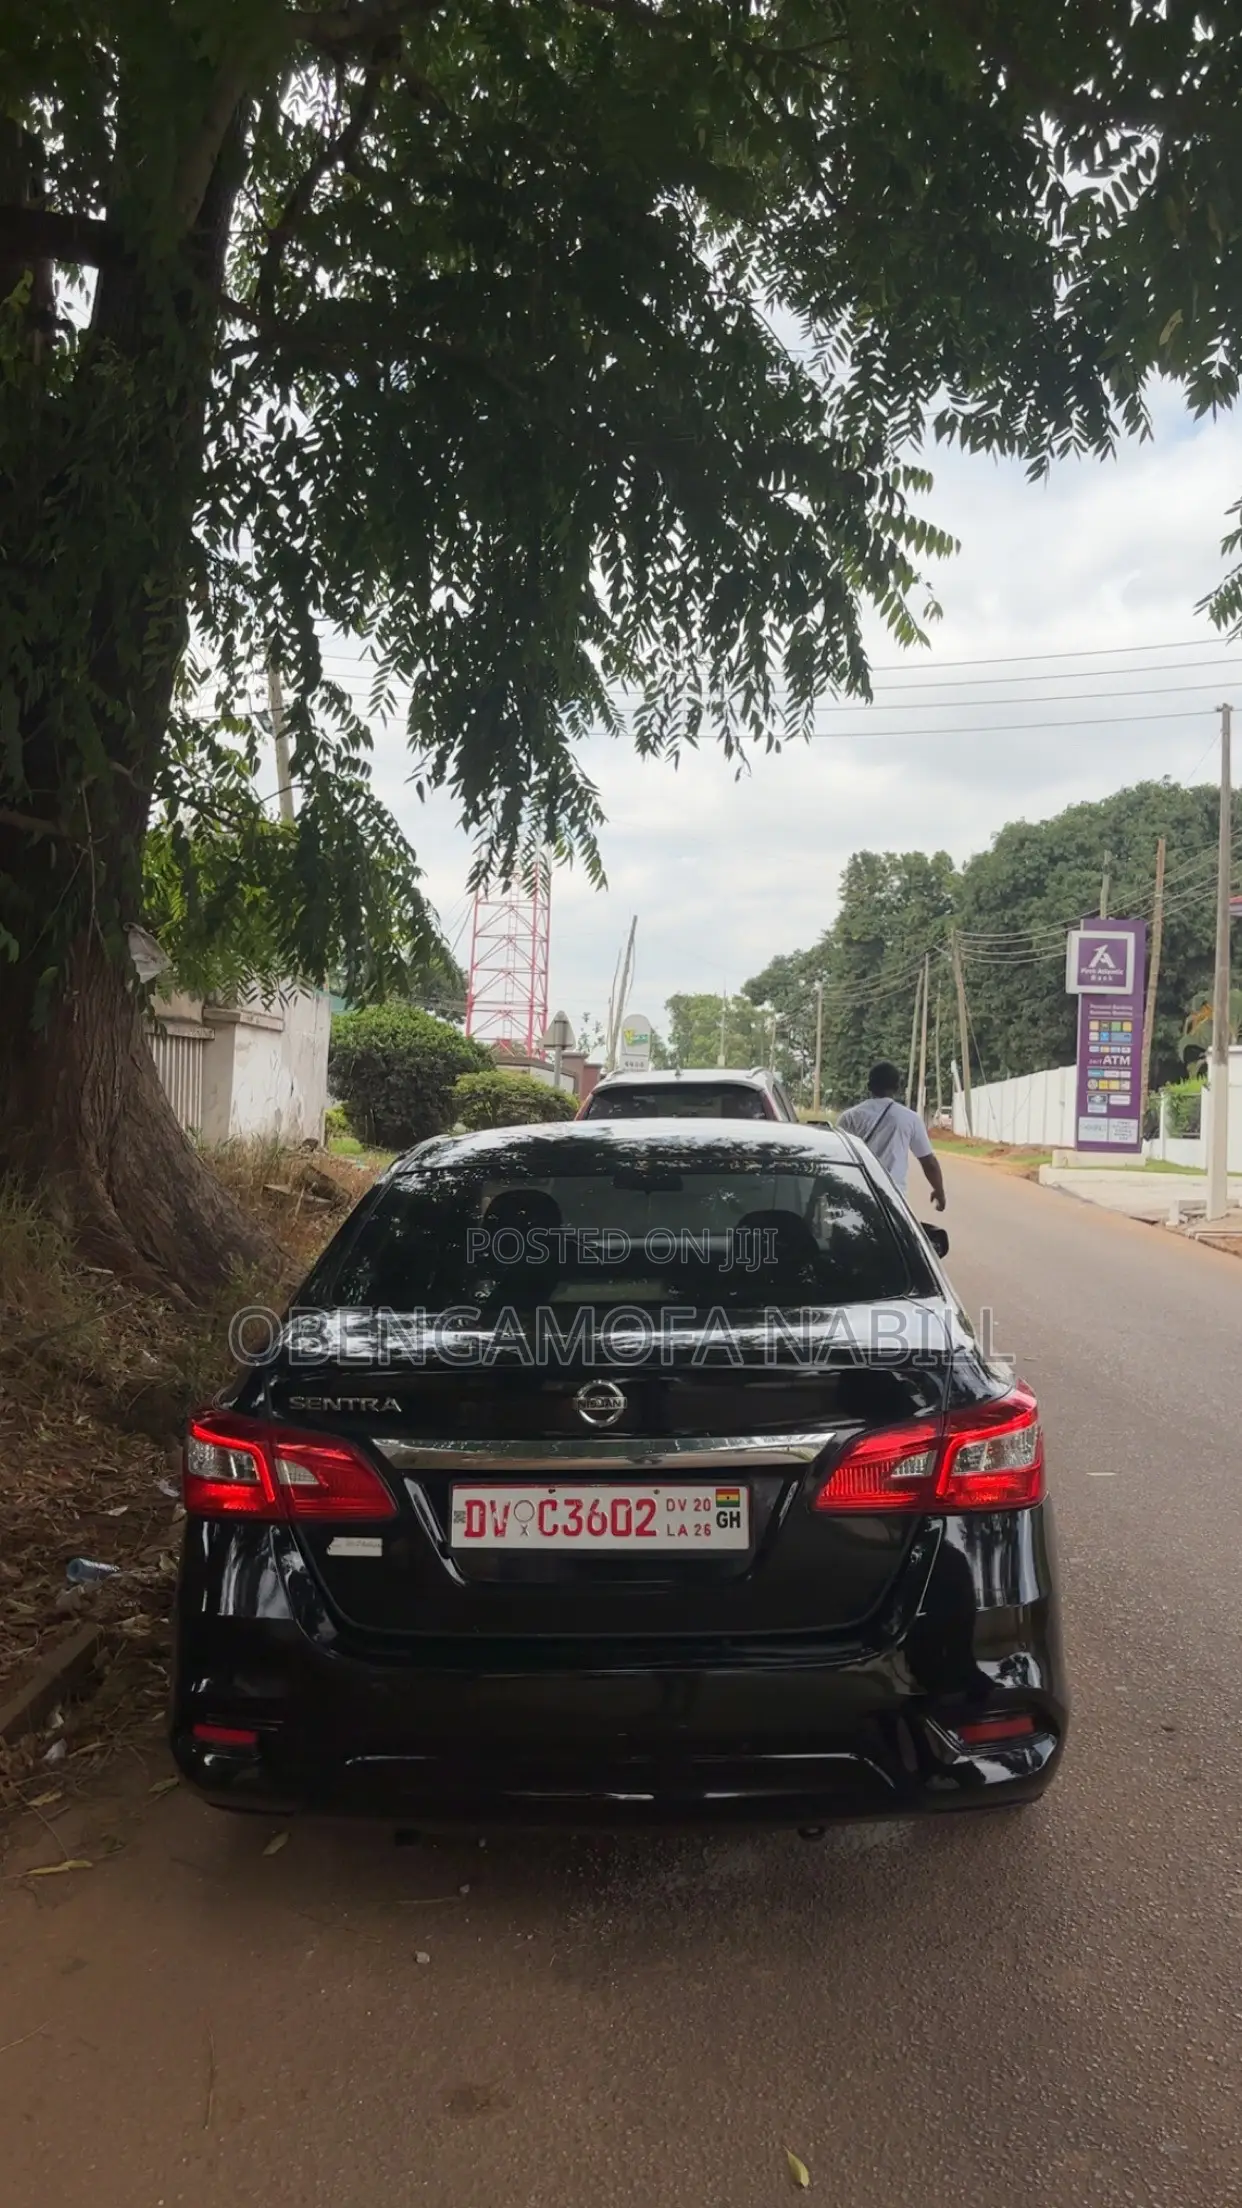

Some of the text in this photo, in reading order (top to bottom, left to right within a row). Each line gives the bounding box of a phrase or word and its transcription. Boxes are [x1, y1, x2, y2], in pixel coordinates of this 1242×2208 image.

[1103, 1055, 1131, 1066] ATM
[289, 1396, 402, 1412] SENTRA
[578, 1397, 624, 1409] NISSAN
[666, 1498, 712, 1512] DV 20
[464, 1498, 658, 1538] DV C3602
[716, 1510, 741, 1529] GH
[666, 1523, 712, 1537] LA 26
